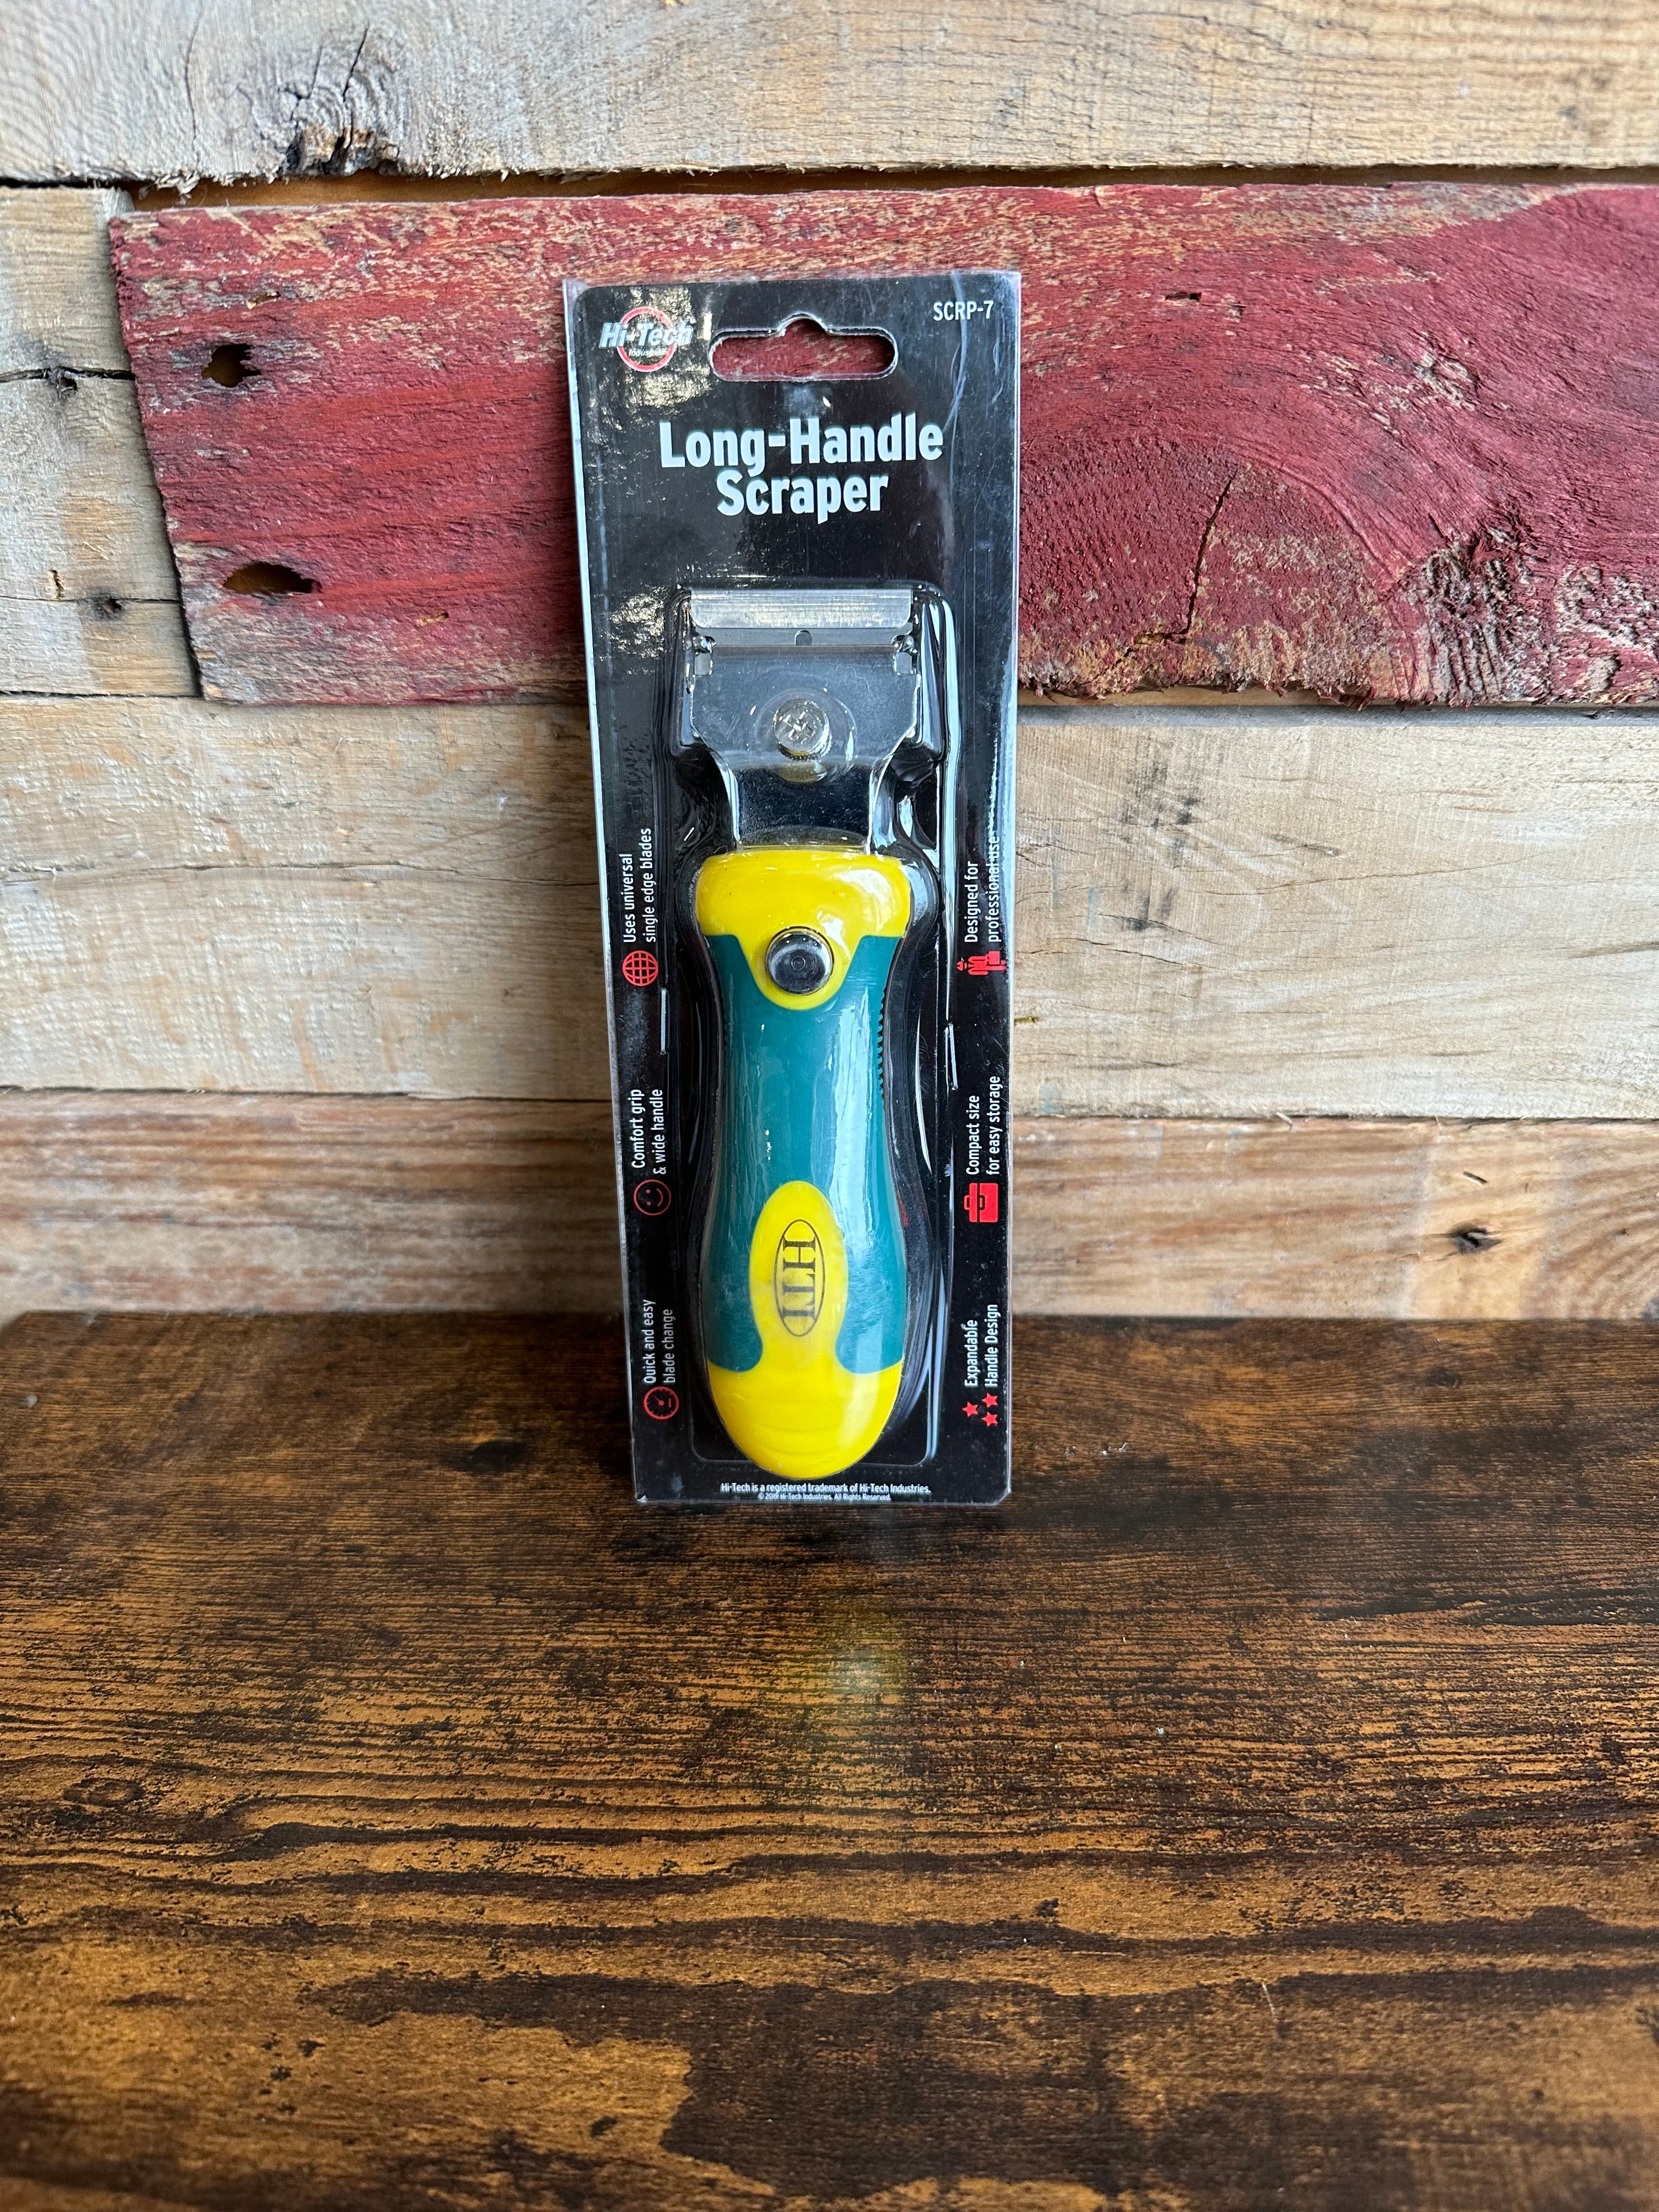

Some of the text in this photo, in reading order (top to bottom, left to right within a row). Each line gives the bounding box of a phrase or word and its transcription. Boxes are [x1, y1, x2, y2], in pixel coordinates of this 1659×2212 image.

[933, 299, 994, 321] SCRP-7
[659, 412, 944, 478] Long-Handle
[716, 469, 889, 525] Scraper
[619, 854, 636, 943] Uses universal
[639, 827, 658, 943] single edge blades
[964, 861, 981, 943] Designed for
[985, 863, 1002, 943] professional
[628, 1089, 646, 1169] Comfort grip
[650, 1089, 667, 1175] & wide handle
[966, 1095, 983, 1175] Compact size
[986, 1076, 1003, 1175] for easy storage
[641, 1299, 656, 1384] Quick and easy
[662, 1309, 676, 1384] blade change
[964, 1319, 981, 1387] Expandable
[984, 1304, 1001, 1387] Handle Design
[720, 1482, 751, 1493] Hi-Tech
[752, 1482, 759, 1492] is
[765, 1482, 806, 1493] registered
[808, 1482, 849, 1493] trademark
[850, 1482, 858, 1492] of
[860, 1483, 889, 1493] Hi-Tech
[890, 1483, 932, 1493] Industries.
[843, 1493, 861, 1502] Rights
